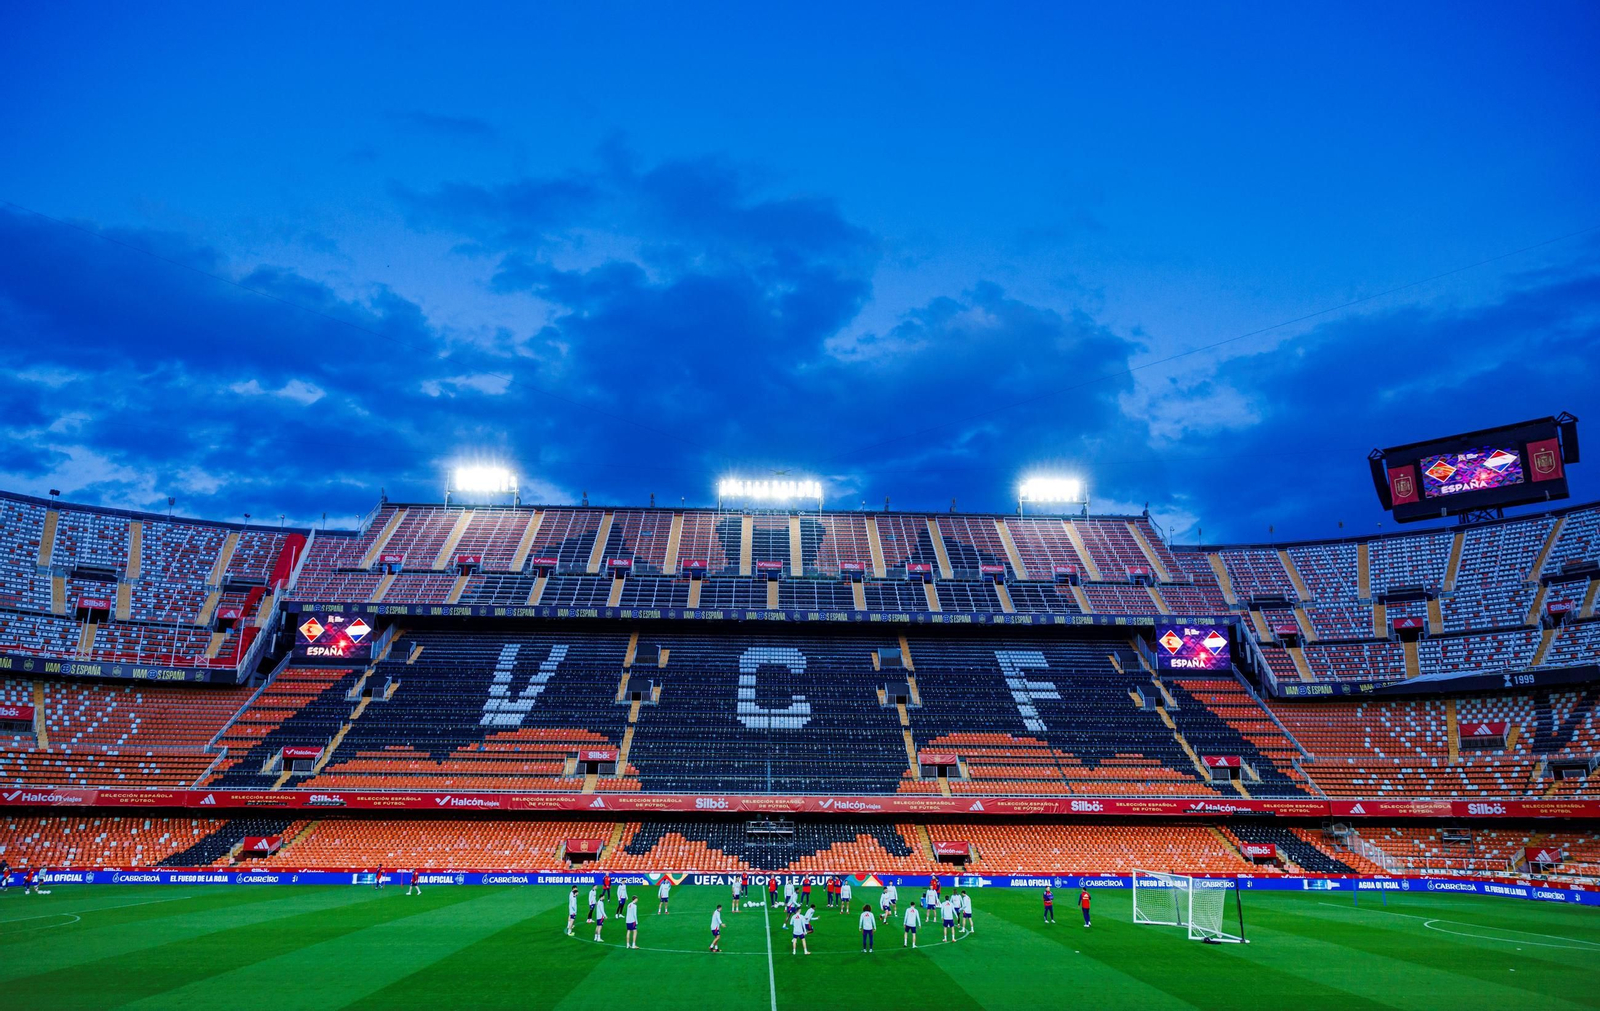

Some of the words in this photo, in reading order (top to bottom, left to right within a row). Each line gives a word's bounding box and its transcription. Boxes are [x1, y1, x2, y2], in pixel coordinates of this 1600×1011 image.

[1441, 480, 1488, 494] ESPAÑA
[306, 646, 343, 656] ESPAÑA
[1171, 658, 1206, 667] ESPAÑA
[76, 664, 101, 676] ESPAÑA
[162, 669, 185, 680] ESPAÑA
[1514, 674, 1534, 684] 1999
[1313, 685, 1333, 694] ESPAÑA
[22, 793, 63, 802] Halcón
[451, 797, 483, 806] Halcón
[696, 798, 728, 809] Silbö:
[834, 800, 865, 809] Halcón
[1071, 801, 1103, 811] Silbö:
[1206, 804, 1236, 812] Halcón
[1468, 804, 1506, 814] Silbö:
[694, 876, 724, 885] UEFA
